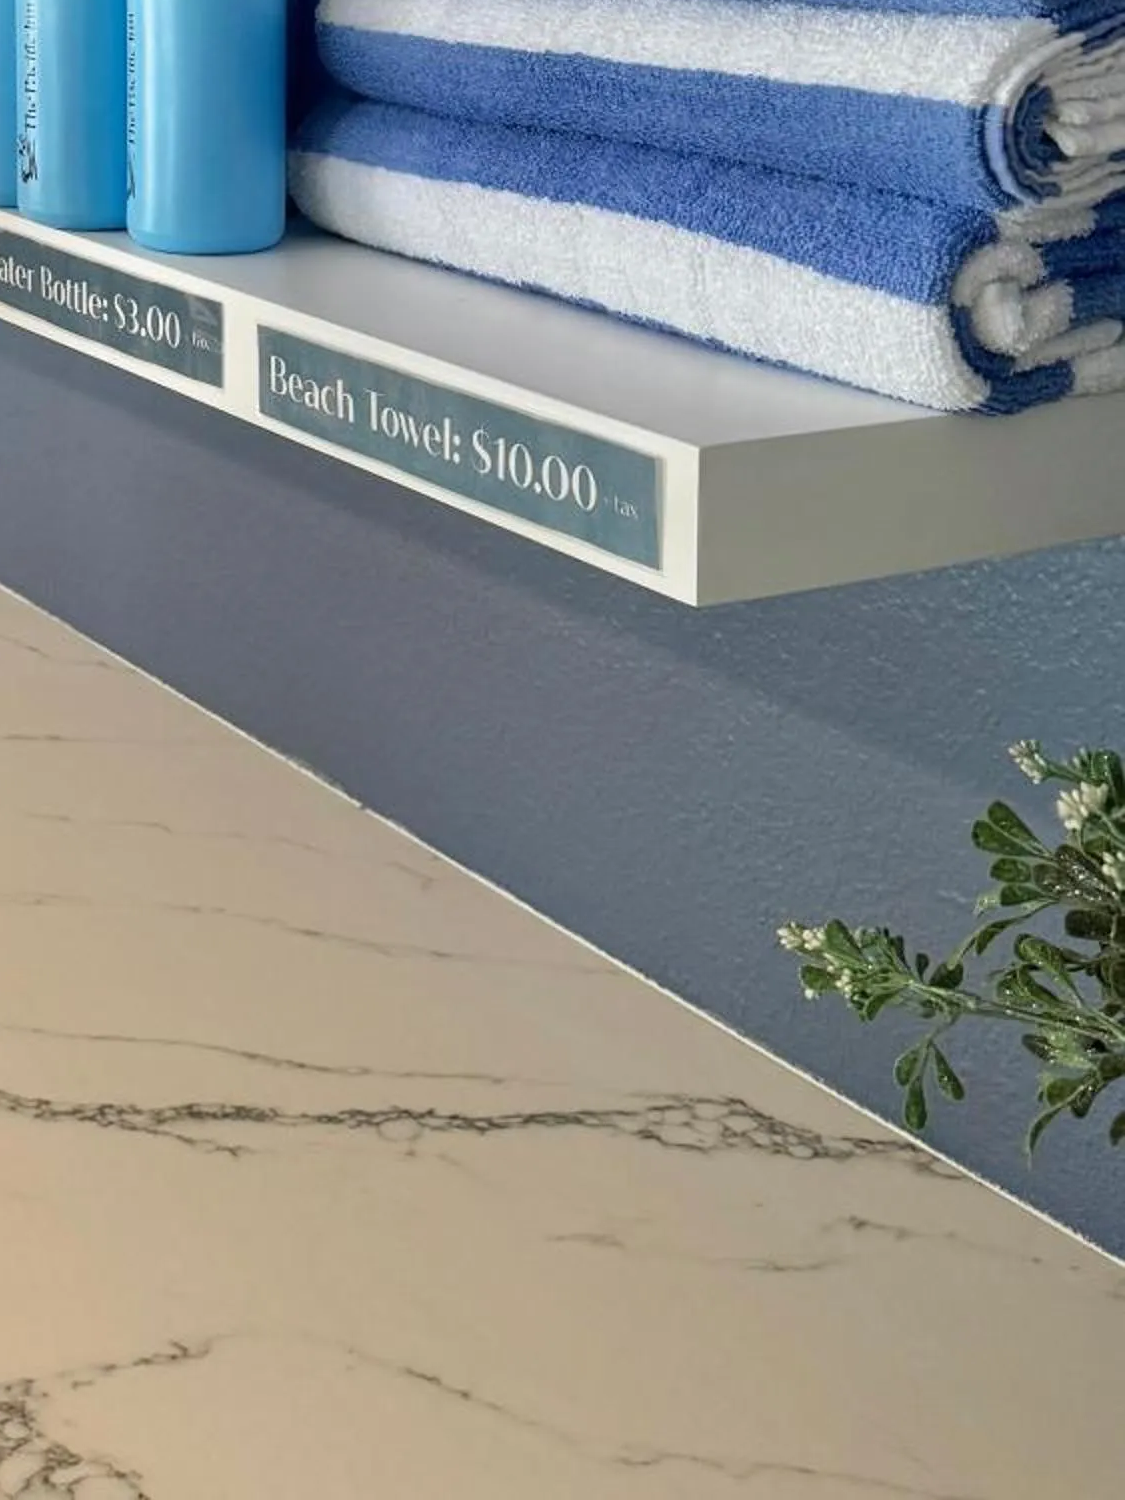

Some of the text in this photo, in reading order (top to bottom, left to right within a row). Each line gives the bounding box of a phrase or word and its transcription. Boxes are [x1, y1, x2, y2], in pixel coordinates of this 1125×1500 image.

[40, 264, 109, 322] Bottle:
[114, 294, 181, 350] $3.00
[269, 355, 355, 423] Beach
[363, 388, 462, 465] Towel:
[472, 423, 598, 513] $10.00
